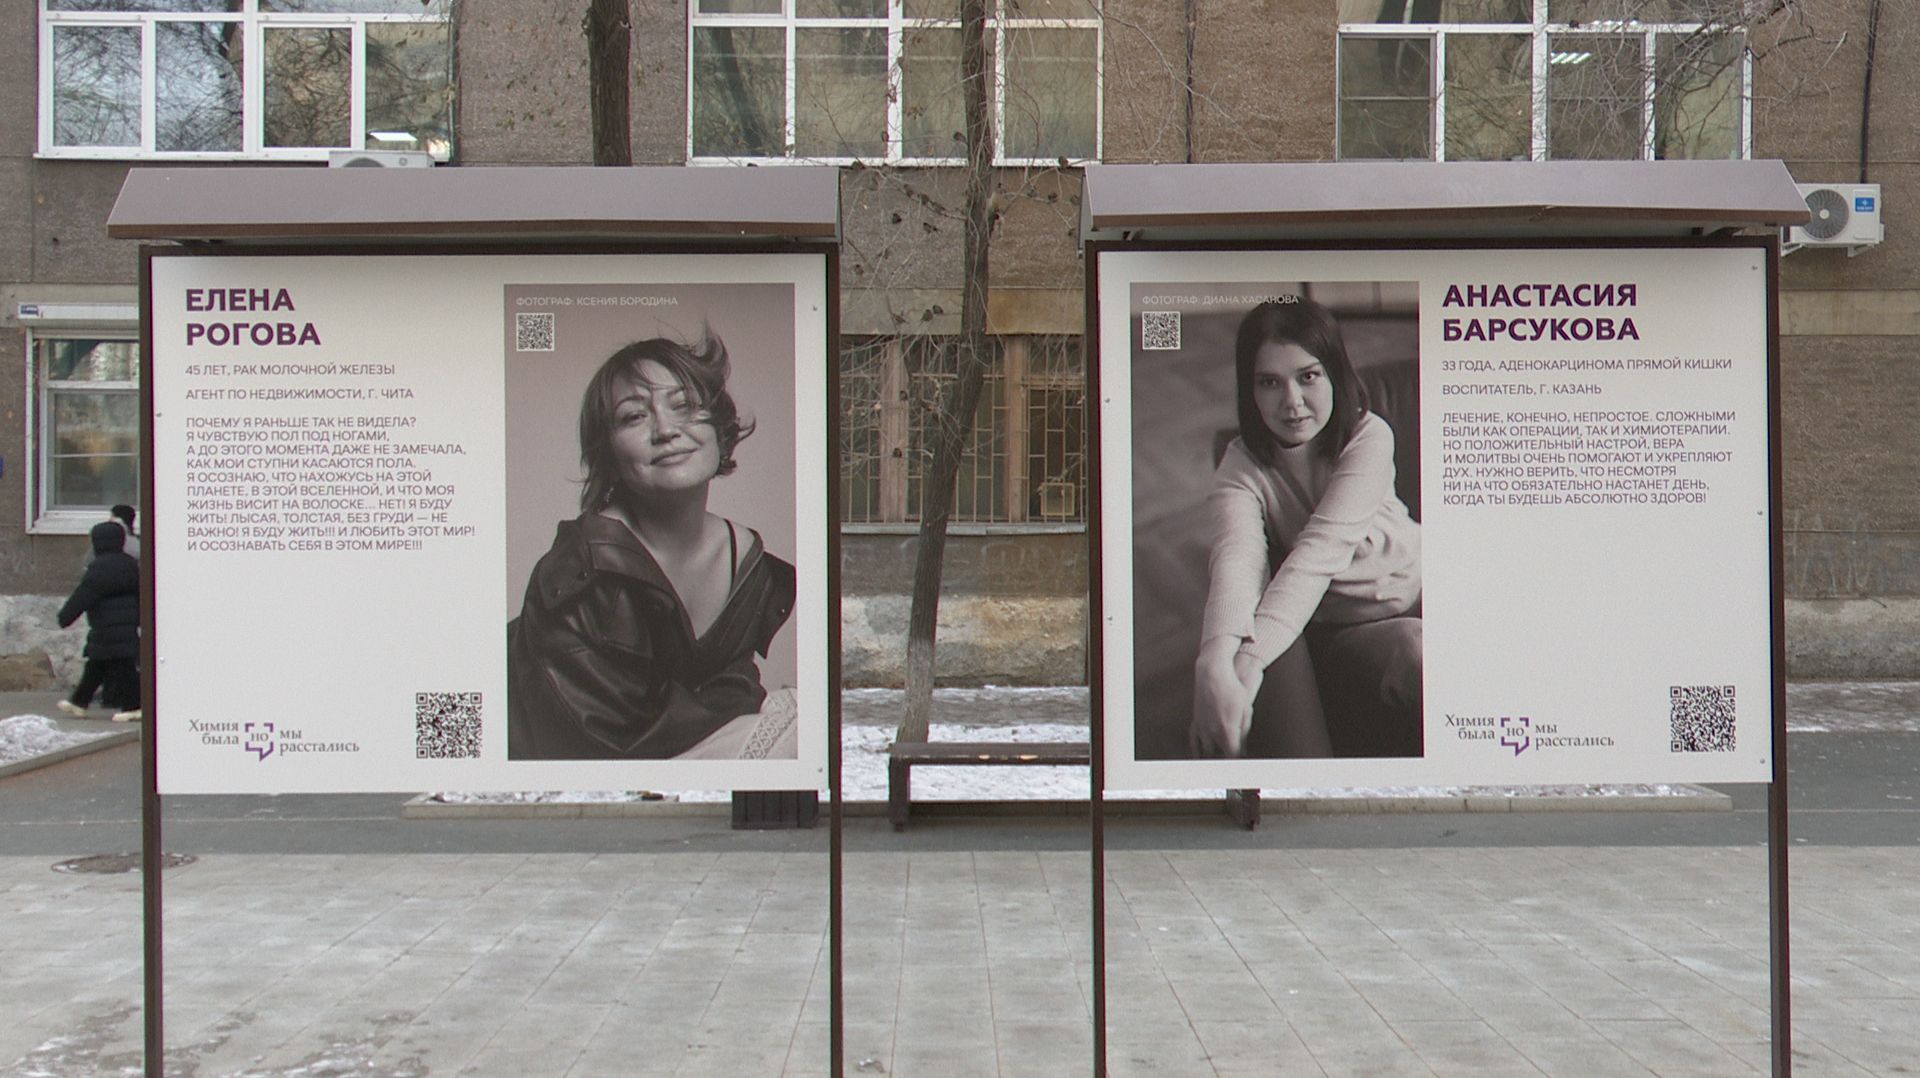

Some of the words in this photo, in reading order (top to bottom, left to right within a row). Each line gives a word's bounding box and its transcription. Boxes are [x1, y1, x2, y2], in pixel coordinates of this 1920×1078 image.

[186, 288, 295, 311] ЕЛЕНА
[577, 296, 617, 306] КСЕНИЯ
[620, 296, 678, 307] БОРОДИНА
[1202, 296, 1239, 306] ДИАНА
[1241, 295, 1299, 305] ХАСАНОВА
[1442, 284, 1637, 308] АНАСТАСИЯ
[186, 323, 321, 346] РОГОВА
[1443, 318, 1640, 342] БАРСУКОВА
[185, 366, 200, 375] 45
[203, 365, 231, 376] ЛЕТ,
[234, 365, 257, 375] РАК
[260, 361, 336, 375] МОЛОЧНОЙ
[339, 364, 395, 375] ЖЕЛЕЗЫ
[1442, 360, 1456, 371] 33
[1459, 360, 1495, 372] ГОДА,
[1498, 360, 1624, 372] АДЕНОКАРЦИНОМА
[1627, 356, 1681, 370] ПРЯМОЙ
[1684, 359, 1732, 370] КИШКИ
[186, 389, 225, 400] АГЕНТ
[228, 389, 247, 400] ПО
[250, 389, 365, 401] НЕДВИЖИМОСТИ,
[368, 389, 378, 399] Г.
[382, 389, 413, 399] ЧИТА
[1442, 384, 1536, 396] ВОСПИТАТЕЛЬ,
[1539, 384, 1550, 395] Г.
[1553, 384, 1602, 395] КАЗАНЬ
[186, 417, 240, 428] ПОЧЕМУ
[243, 417, 251, 428] Я
[254, 417, 309, 428] РАНЬШЕ
[312, 417, 334, 428] ТАК
[338, 417, 354, 428] НЕ
[357, 416, 416, 429] ВИДЕЛА?
[1442, 413, 1503, 423] ЛЕЧЕНИЕ,
[1506, 412, 1570, 423] КОНЕЧНО,
[1656, 411, 1736, 422] СЛОЖНЫМИ
[186, 431, 194, 441] Я
[197, 431, 268, 441] ЧУВСТВУЮ
[272, 431, 298, 441] ПОЛ
[302, 431, 330, 442] ПОД
[332, 430, 390, 442] НОГАМИ,
[1443, 426, 1480, 437] БЫЛИ
[1483, 426, 1506, 437] КАК
[1510, 426, 1582, 438] ОПЕРАЦИИ,
[1586, 426, 1608, 436] ТАК
[1610, 426, 1620, 436] И
[1623, 425, 1730, 435] ХИМИОТЕРАПИИ.
[1443, 440, 1461, 450] НО
[1464, 436, 1583, 450] ПОЛОЖИТЕЛЬНЫЙ
[1586, 436, 1650, 450] НАСТРОЙ,
[1654, 439, 1684, 449] ВЕРА
[186, 445, 196, 455] А
[198, 445, 218, 457] ДО
[220, 445, 262, 455] ЭТОГО
[266, 445, 330, 455] МОМЕНТА
[332, 444, 370, 456] ДАЖЕ
[374, 444, 390, 455] НЕ
[392, 444, 466, 455] ЗАМЕЧАЛА,
[187, 458, 212, 469] КАК
[214, 458, 244, 469] МОИ
[247, 458, 299, 469] СТУПНИ
[302, 458, 373, 469] КАСАЮТСЯ
[376, 458, 416, 468] ПОЛА.
[1444, 454, 1452, 464] И
[1455, 454, 1520, 464] МОЛИТВЫ
[1523, 454, 1566, 464] ОЧЕНЬ
[1568, 452, 1641, 463] ПОМОГАЮТ
[1644, 452, 1652, 462] И
[1656, 452, 1732, 462] УКРЕПЛЯЮТ
[187, 472, 194, 483] Я
[198, 472, 269, 483] ОСОЗНАЮ,
[272, 472, 296, 483] ЧТО
[300, 472, 374, 483] НАХОЖУСЬ
[376, 472, 394, 482] НА
[396, 468, 432, 482] ЭТОЙ
[1443, 467, 1472, 479] ДУХ.
[1476, 467, 1524, 478] НУЖНО
[1527, 467, 1578, 478] ВЕРИТЬ,
[1580, 466, 1604, 477] ЧТО
[1608, 466, 1676, 476] НЕСМОТРЯ
[187, 486, 248, 497] ПЛАНЕТЕ,
[251, 486, 260, 496] В
[262, 483, 298, 496] ЭТОЙ
[300, 482, 382, 496] ВСЕЛЕННОЙ,
[386, 485, 395, 495] И
[398, 485, 422, 495] ЧТО
[425, 485, 454, 495] МОЯ
[1444, 481, 1460, 491] НИ
[1464, 481, 1482, 491] НА
[1484, 481, 1508, 491] ЧТО
[1512, 480, 1603, 491] ОБЯЗАТЕЛЬНО
[1606, 480, 1670, 490] НАСТАНЕТ
[1672, 479, 1710, 491] ДЕНЬ,
[187, 500, 232, 510] ЖИЗНЬ
[236, 500, 279, 510] ВИСИТ
[282, 500, 299, 510] НА
[379, 499, 406, 509] НЕТ!
[408, 499, 416, 509] Я
[420, 499, 452, 510] БУДУ
[1444, 495, 1484, 506] КОГДА
[1488, 495, 1505, 505] ТЫ
[1508, 494, 1562, 506] БУДЕШЬ
[1565, 494, 1648, 504] АБСОЛЮТНО
[1650, 493, 1706, 505] ЗДОРОВ!
[187, 513, 226, 523] ЖИТЬ!
[230, 513, 280, 524] ЛЫСАЯ,
[283, 513, 344, 523] ТОЛСТАЯ,
[348, 513, 370, 523] БЕЗ
[374, 512, 414, 524] ГРУДИ
[432, 512, 448, 523] НЕ
[188, 527, 239, 537] ВАЖНО!
[242, 527, 250, 537] Я
[253, 527, 285, 538] БУДУ
[288, 526, 335, 537] ЖИТЬ!!!
[338, 526, 347, 537] И
[350, 526, 405, 537] ЛЮБИТЬ
[408, 526, 440, 536] ЭТОТ
[443, 526, 475, 536] МИР!
[188, 540, 196, 551] И
[200, 540, 286, 551] ОСОЗНАВАТЬ
[288, 540, 322, 551] СЕБЯ
[324, 540, 333, 551] В
[336, 540, 372, 551] ЭТОМ
[376, 540, 422, 550] МИРЕ!!!
[189, 719, 239, 732] Химия
[1445, 714, 1495, 727] Химия
[280, 730, 301, 740] мы
[1458, 727, 1495, 740] была
[1507, 727, 1524, 736] но
[1535, 724, 1557, 734] мы
[201, 732, 239, 745] была
[251, 732, 269, 742] но
[1535, 736, 1614, 751] расстались
[279, 742, 359, 756] расстались
